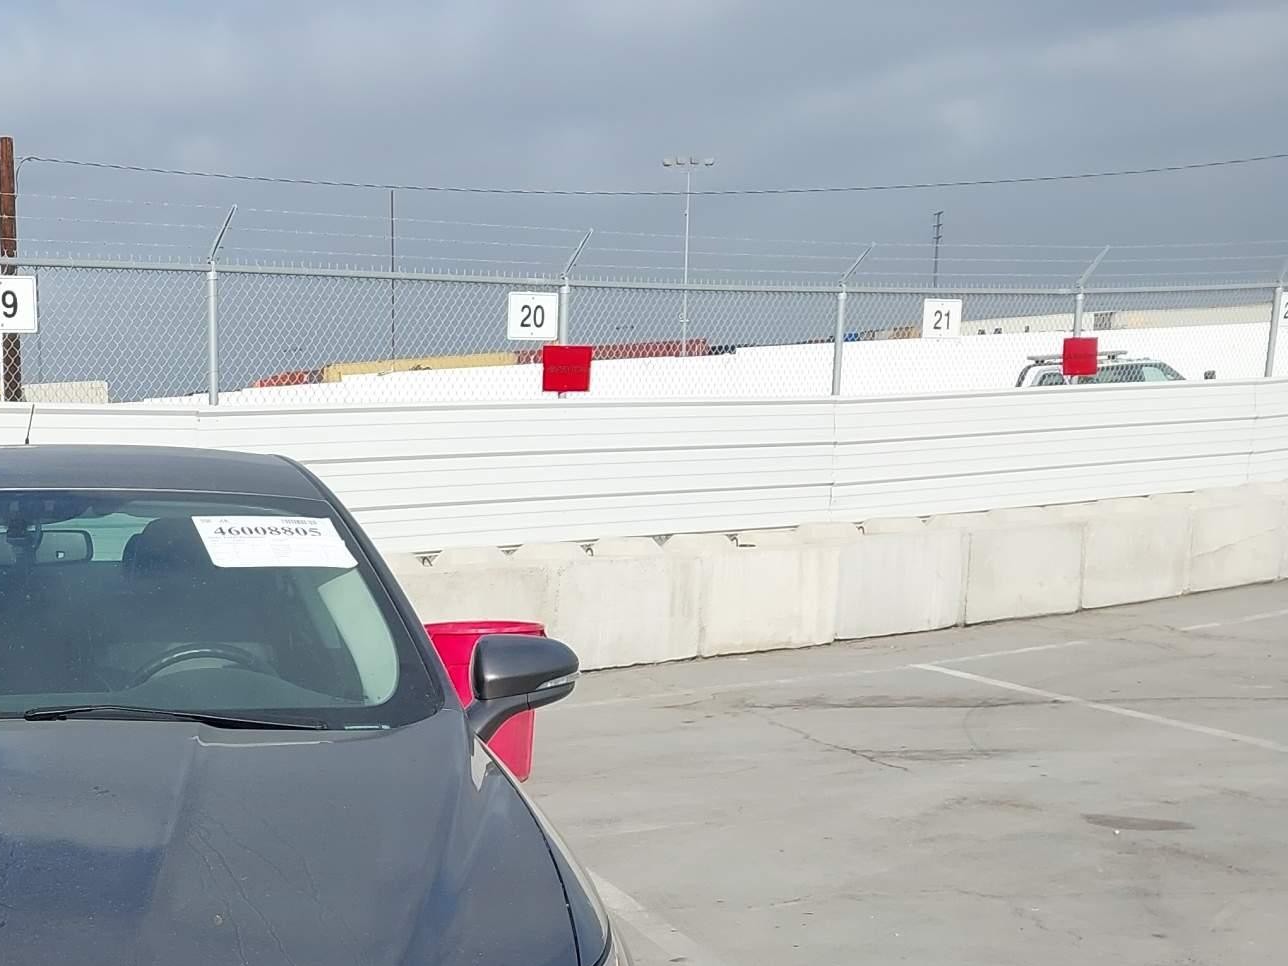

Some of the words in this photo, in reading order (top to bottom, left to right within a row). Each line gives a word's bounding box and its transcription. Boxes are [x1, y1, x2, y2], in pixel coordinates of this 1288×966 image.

[520, 304, 545, 328] 20
[933, 309, 951, 330] 21
[214, 526, 322, 537] 46008805
